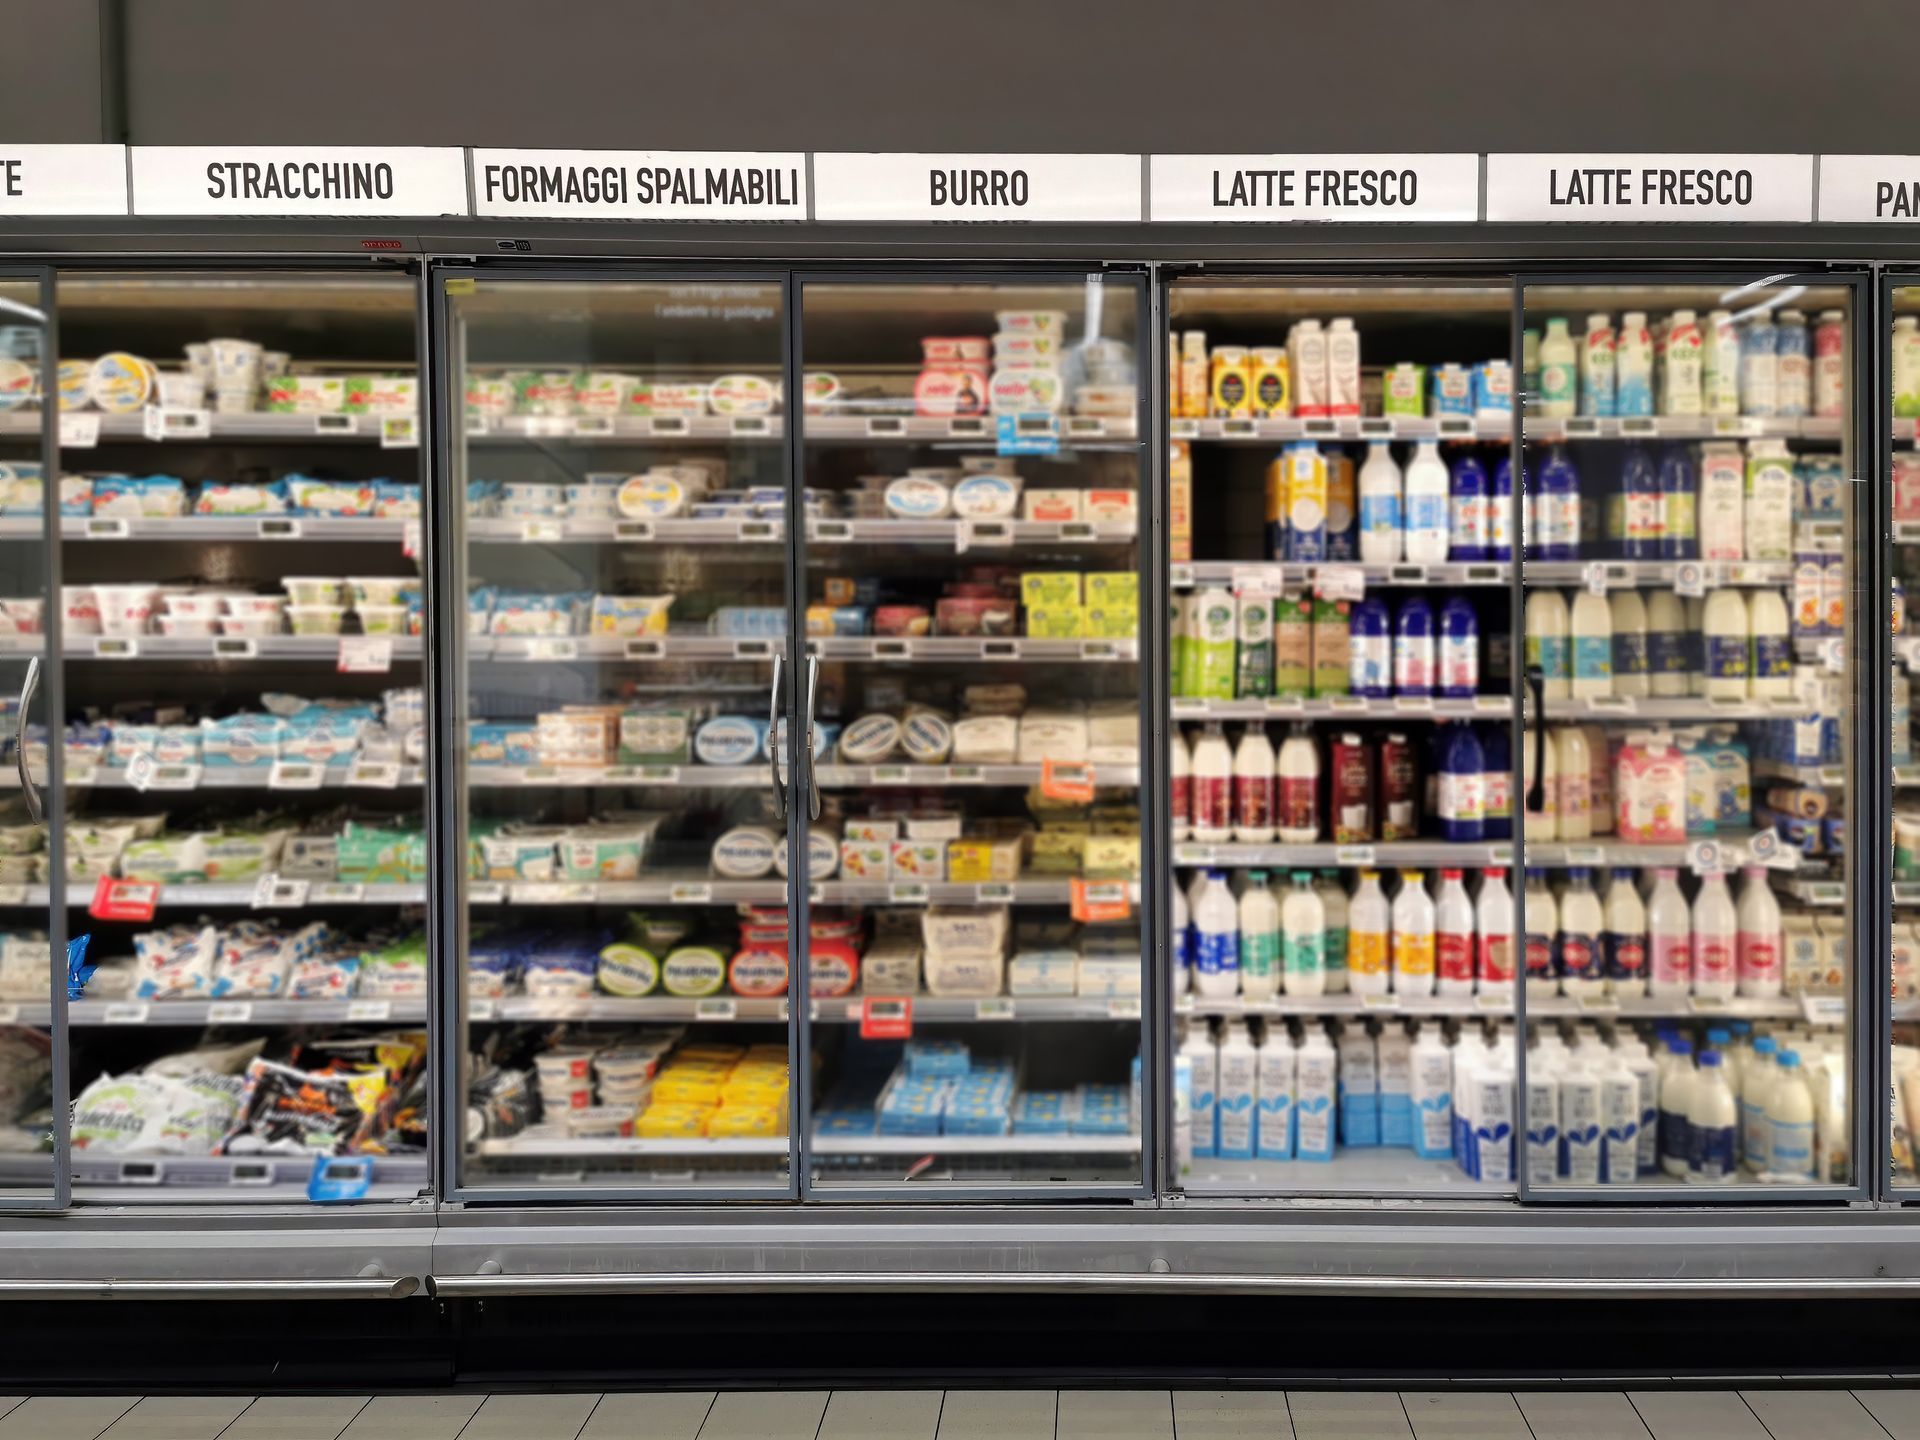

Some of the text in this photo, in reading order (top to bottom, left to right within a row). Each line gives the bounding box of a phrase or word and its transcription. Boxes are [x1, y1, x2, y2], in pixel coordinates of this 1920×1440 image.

[0, 160, 23, 196] E
[206, 162, 393, 200] STRACCHINO
[485, 165, 798, 205] FORMAGGI SPALMABILI
[930, 169, 1029, 207] BURRO
[1213, 169, 1418, 207] LATTE FRESCO
[1550, 169, 1753, 206] LATTE FRESCO
